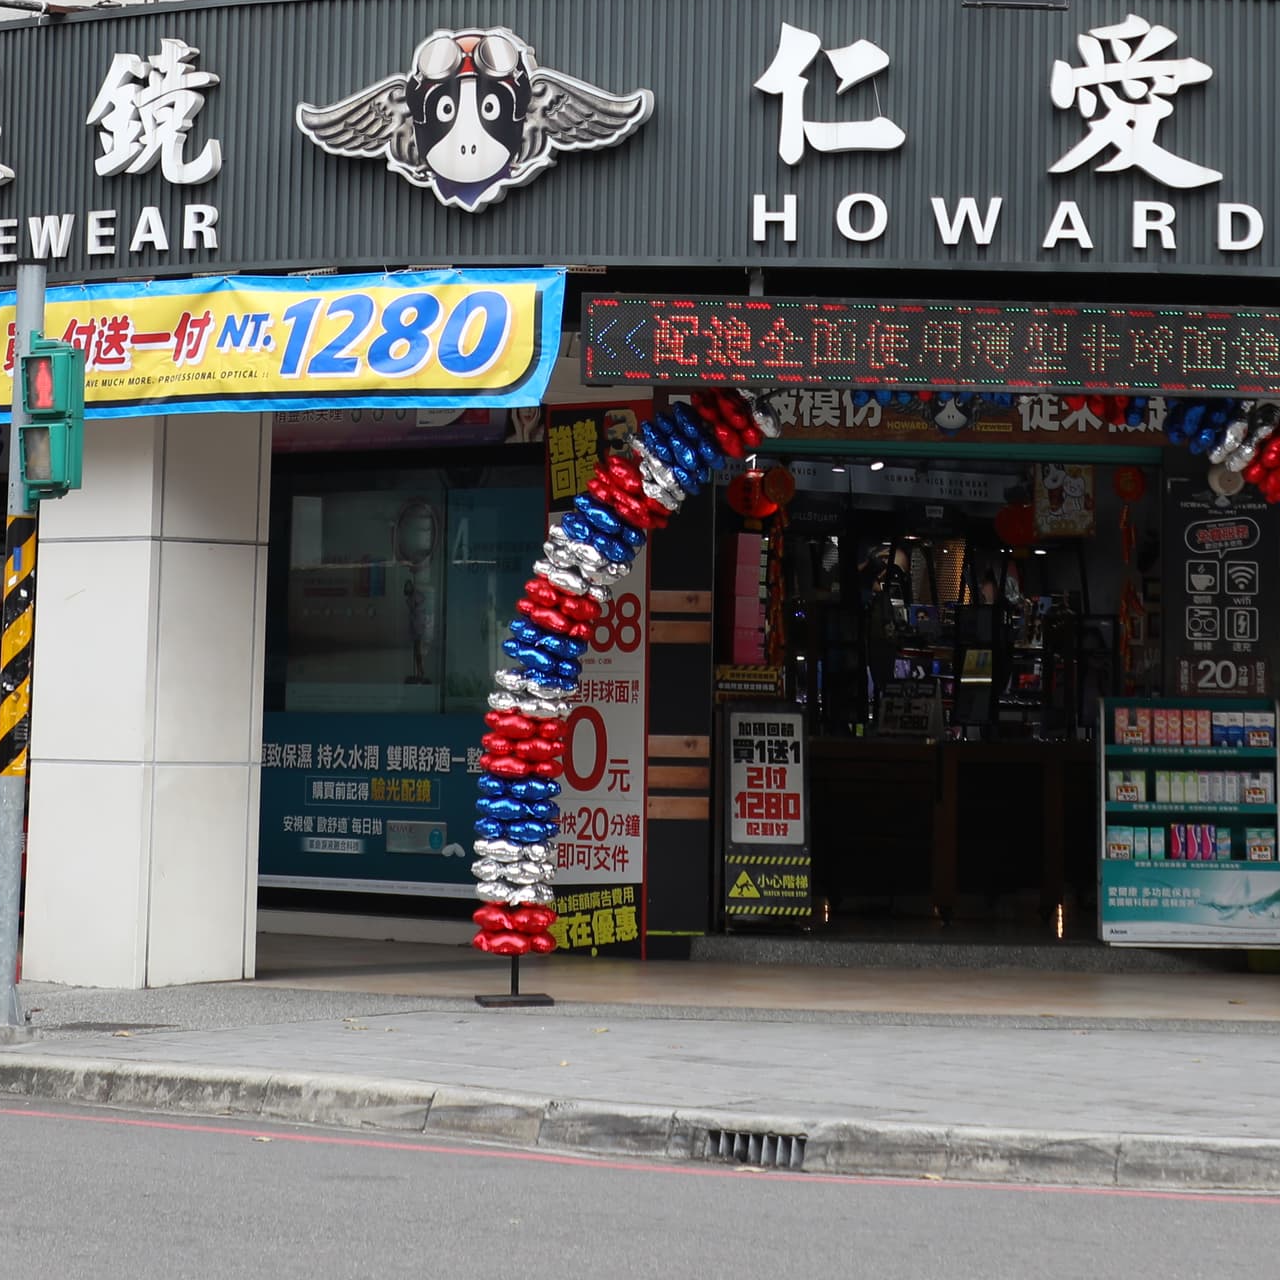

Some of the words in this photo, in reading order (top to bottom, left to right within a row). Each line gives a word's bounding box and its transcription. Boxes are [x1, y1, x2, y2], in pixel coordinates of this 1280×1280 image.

[753, 192, 1265, 251] HOWARD
[4, 310, 212, 371] 付送一付
[216, 312, 272, 349] NT.
[279, 290, 511, 377] 1280
[84, 379, 99, 388] AVE
[101, 378, 125, 387] MUCH
[158, 372, 217, 383] PROFESSIONAL
[220, 370, 258, 380] OPTICAL
[547, 418, 599, 464] 強勢
[1197, 659, 1237, 689] 20
[317, 744, 380, 771] 持久水潤
[386, 744, 486, 774] 雙眼舒適一整
[733, 739, 801, 764] 買1送1
[312, 781, 369, 801] 購買前記得
[371, 777, 432, 803] 驗光配鏡
[746, 766, 787, 790] 2付
[556, 844, 629, 873] 即可交件
[756, 873, 810, 890] 小心階梯
